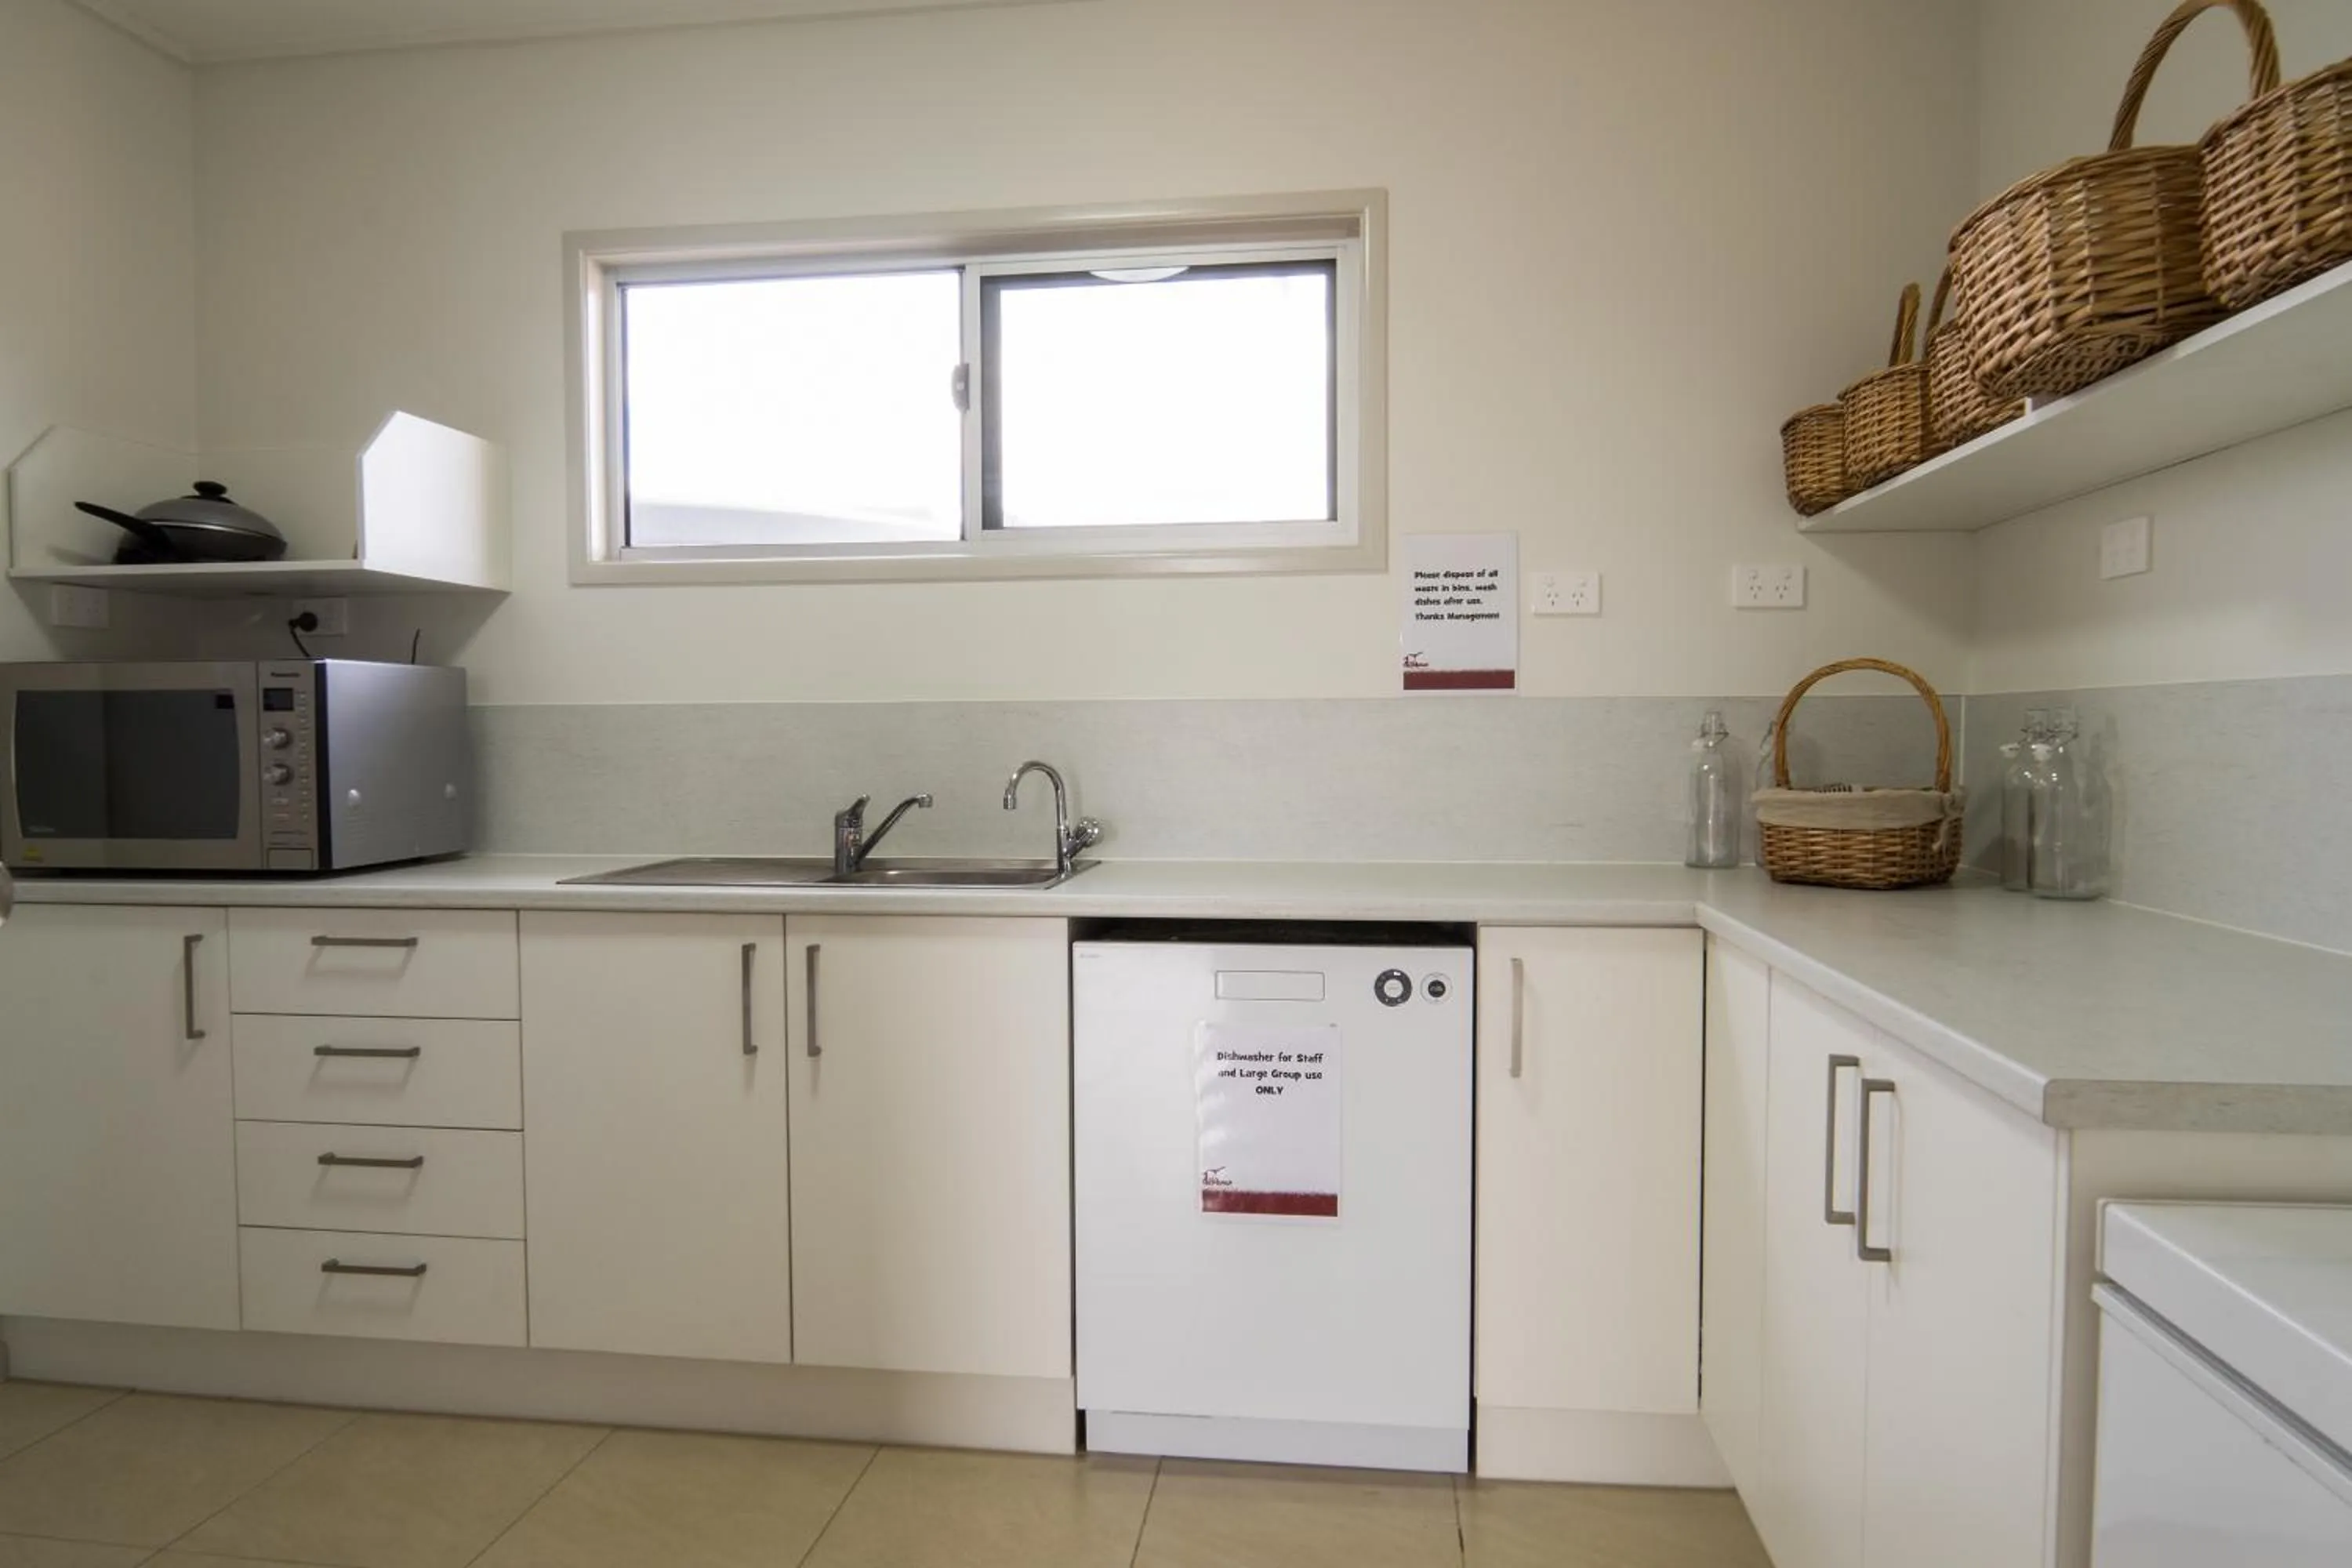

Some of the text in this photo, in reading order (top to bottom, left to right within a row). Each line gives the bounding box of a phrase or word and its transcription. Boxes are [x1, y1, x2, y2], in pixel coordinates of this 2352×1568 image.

[1476, 569, 1486, 579] of
[1442, 583, 1450, 592] in
[1217, 1051, 1323, 1064] Dishwasher for Staff
[1218, 1069, 1236, 1078] and
[1240, 1069, 1268, 1081] Large
[1271, 1069, 1302, 1082] Group
[1255, 1086, 1283, 1095] ONLY
